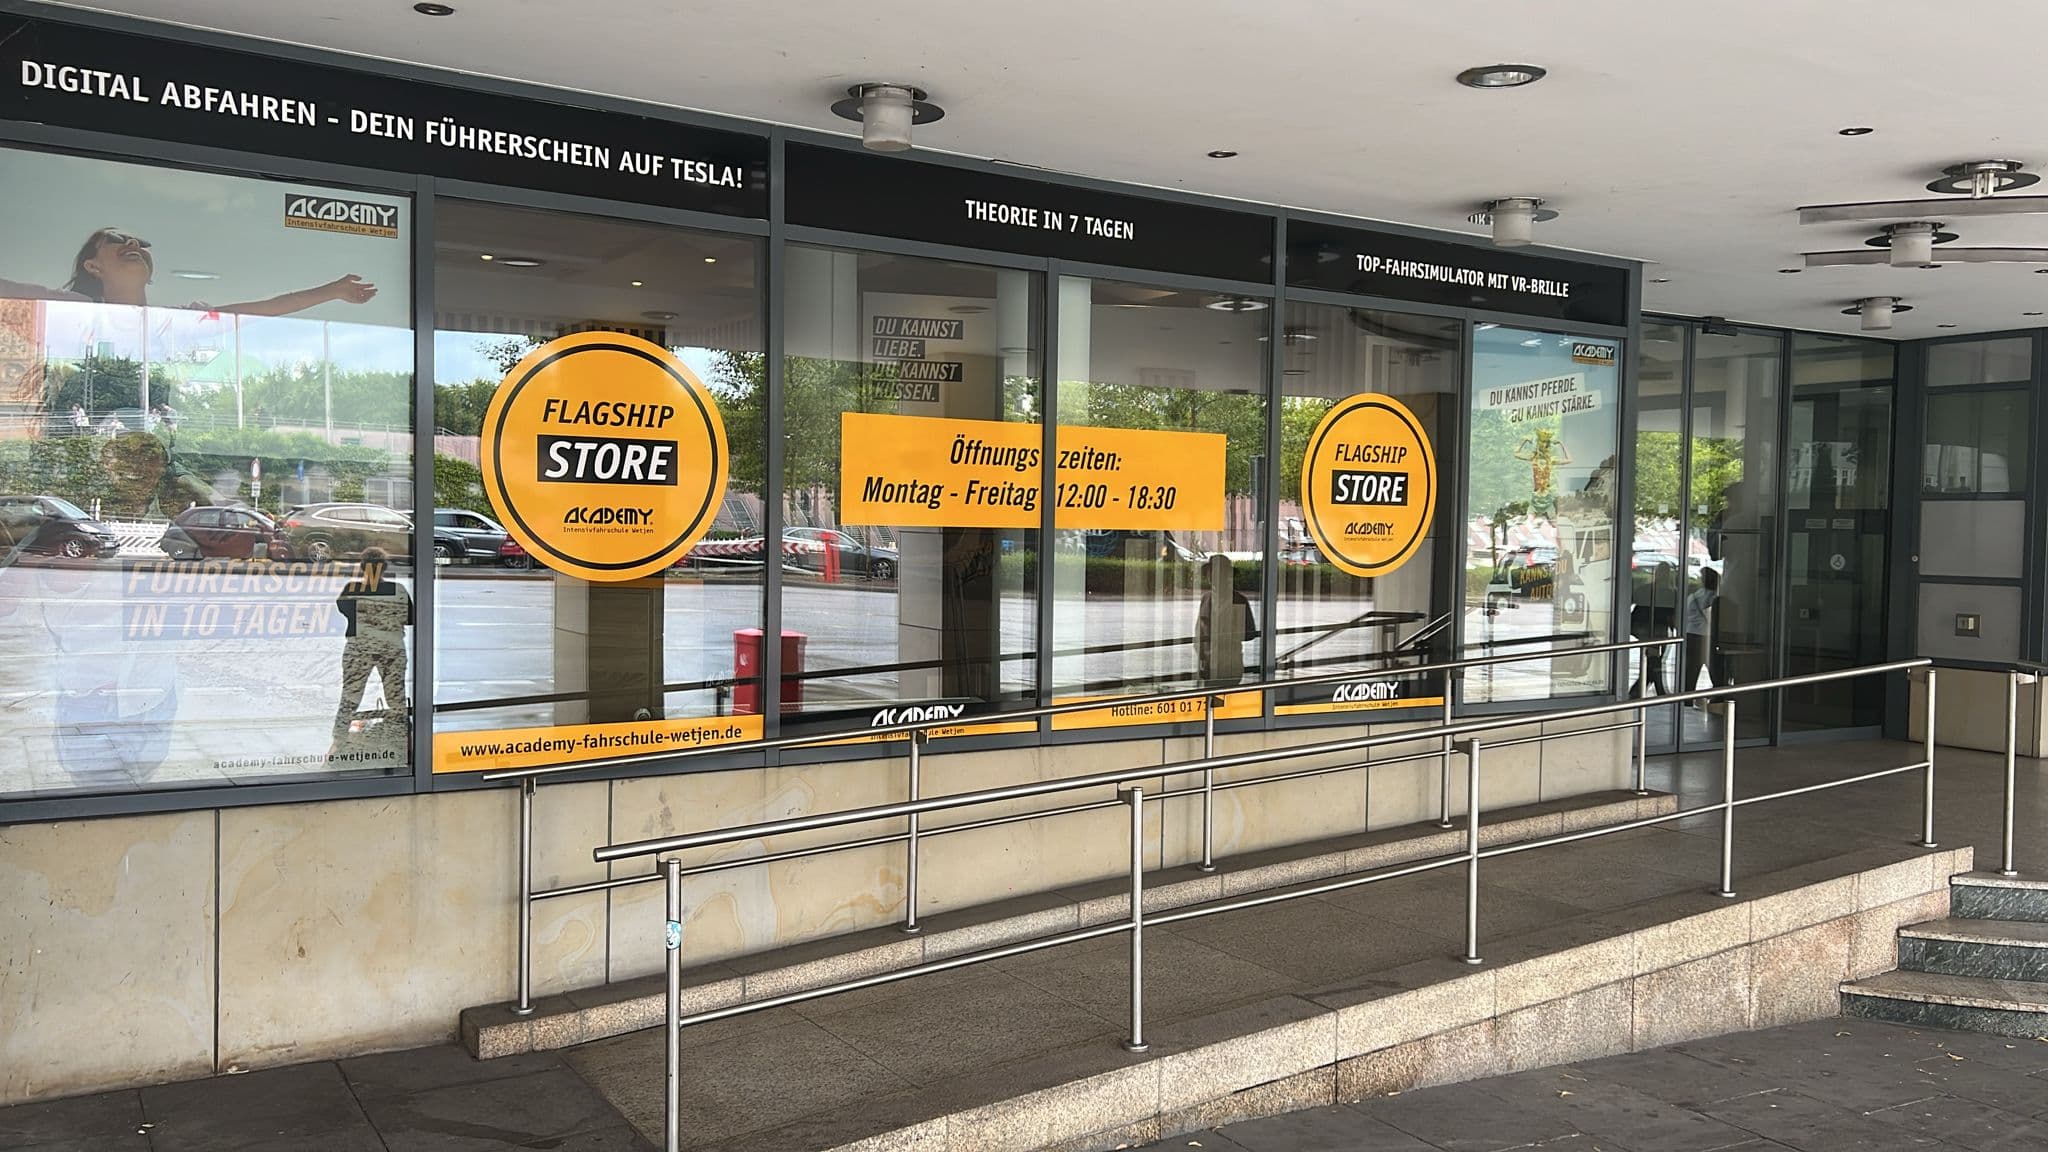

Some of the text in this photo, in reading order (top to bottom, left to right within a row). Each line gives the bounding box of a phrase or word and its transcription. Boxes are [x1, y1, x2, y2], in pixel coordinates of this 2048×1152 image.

[21, 60, 149, 102] DIGITAL
[160, 82, 316, 126] ABFAHREN
[351, 109, 414, 140] DEIN
[426, 117, 610, 169] FÜHRERSCHEIN
[619, 151, 664, 176] AUF
[671, 157, 743, 188] TESLA!
[287, 198, 395, 226] ACADEMY
[965, 199, 1134, 240] THEORIE IN 7 TAGEN
[1356, 254, 1569, 298] TOP-FAHRSIMULATOR MIT VR-BRILLE
[875, 318, 959, 338] DU KANNST
[874, 339, 921, 358] LIEBE.
[900, 361, 959, 380] KANNST
[1490, 377, 1577, 406] DU KANNST PFERDE.
[542, 398, 674, 429] FLAGSHIP
[1526, 400, 1560, 420] KANNST
[544, 440, 672, 481] STORE
[1057, 446, 1122, 471] zeiten:
[1335, 444, 1407, 464] FLAGSHIP
[862, 476, 944, 509] Montag
[965, 479, 1039, 511] Freitag
[1056, 483, 1107, 508] 12:00
[1127, 485, 1176, 510] 18:30
[1335, 474, 1406, 502] STORE
[563, 526, 654, 535] Intensivfahrschule Wetjen
[128, 603, 337, 637] IN 10 TAGEN.
[1111, 703, 1153, 717] Hotline:
[1157, 702, 1176, 714] 601
[1180, 701, 1192, 713] 01
[460, 725, 743, 757] www.academy-fahrschule-wetjen.de
